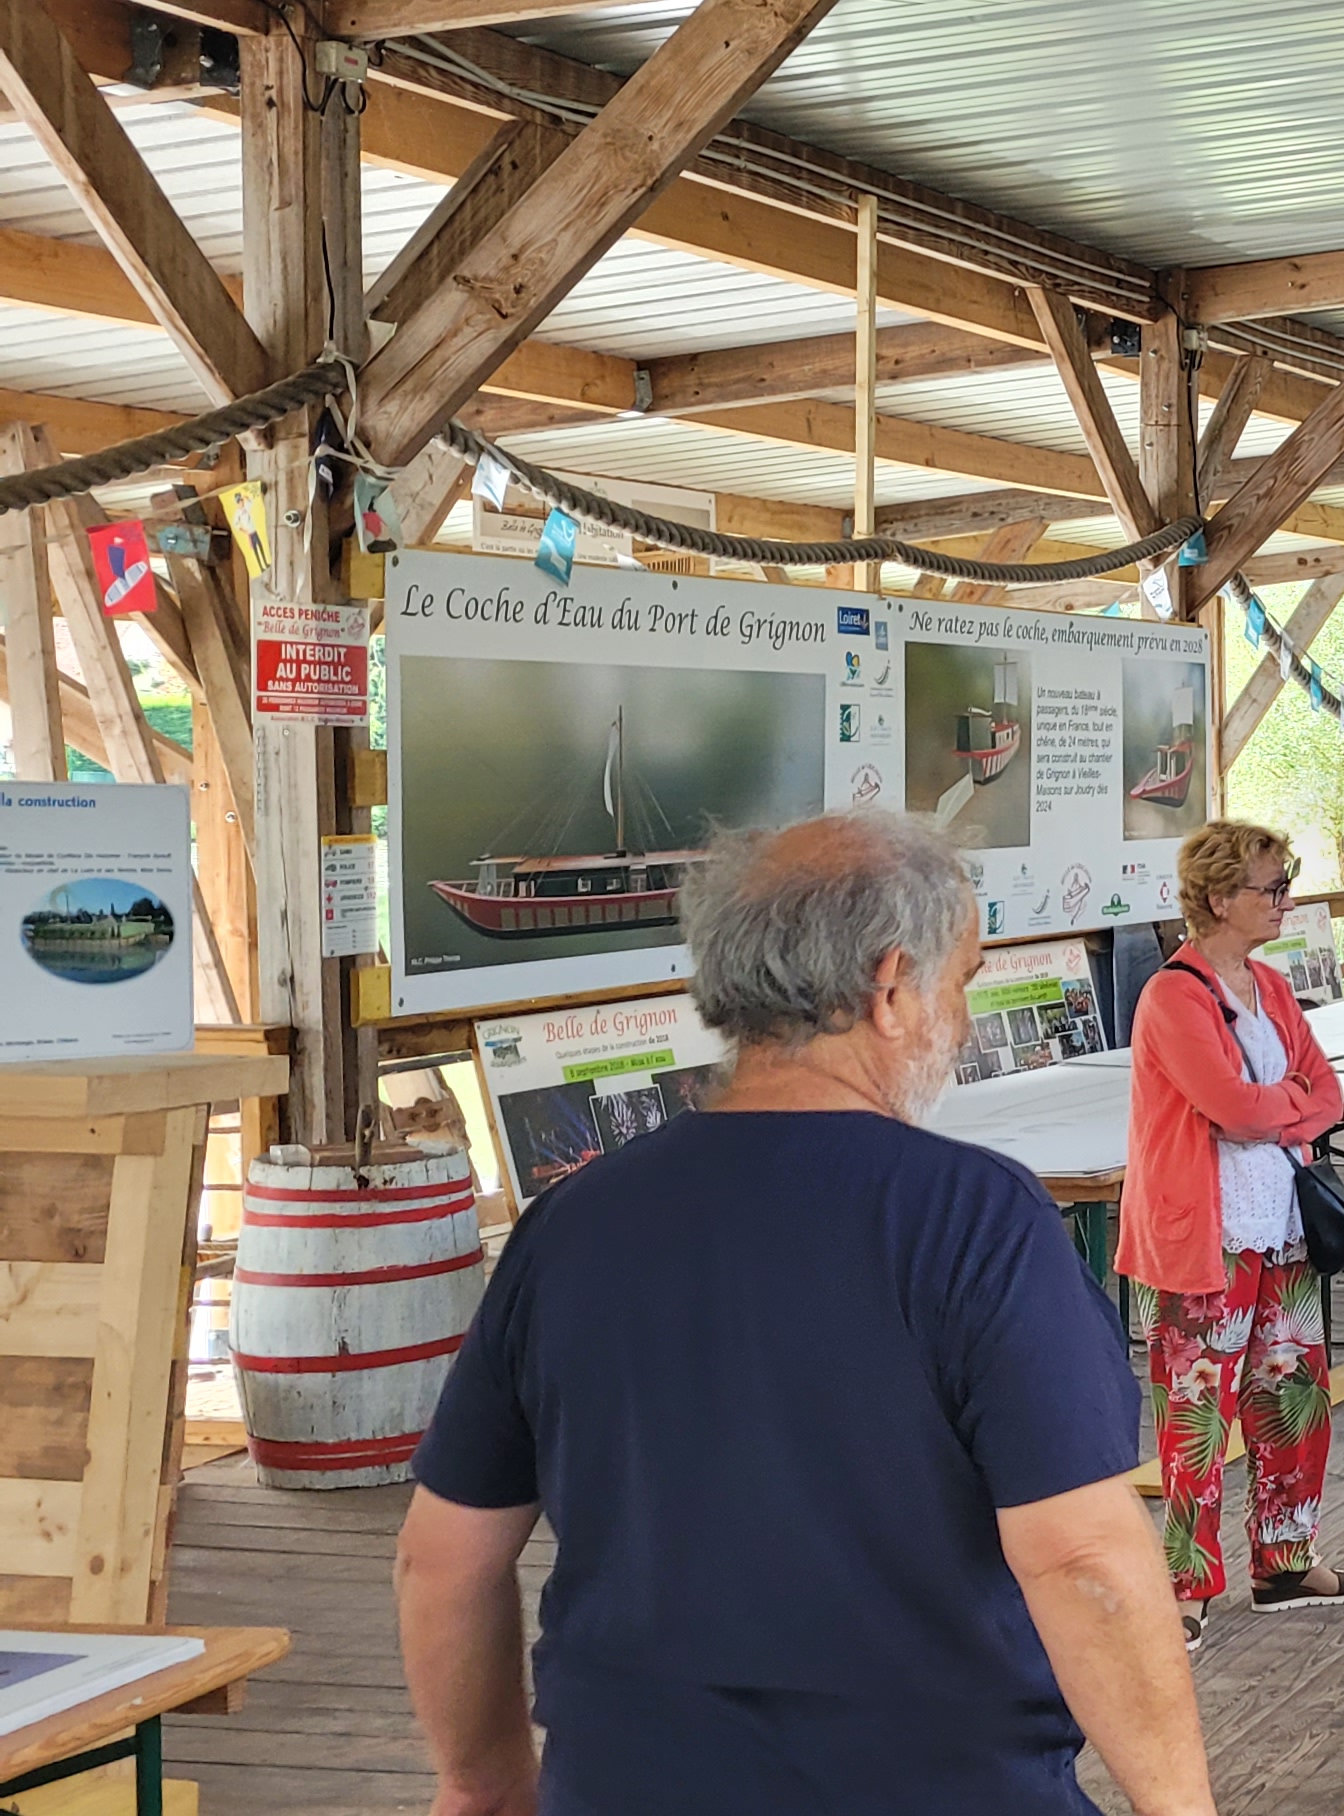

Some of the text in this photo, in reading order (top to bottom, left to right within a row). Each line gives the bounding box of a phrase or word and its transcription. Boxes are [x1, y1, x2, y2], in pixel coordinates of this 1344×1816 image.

[262, 605, 341, 623] ACCES PENICHE
[400, 584, 827, 651] Le Coche d'Eau du Port de Grignon
[839, 611, 863, 626] Loiret
[288, 621, 300, 636] de
[909, 611, 1203, 655] Ne ratez pas le coche, embarquement prévu en 2028
[281, 643, 347, 663] INTERDIT
[276, 662, 352, 681] AU PUBLIC
[268, 680, 359, 694] SANS AUTORISATION
[1, 791, 96, 808] la construction
[1010, 952, 1054, 974] Grignon
[542, 1008, 678, 1043] Belle de Grignon
